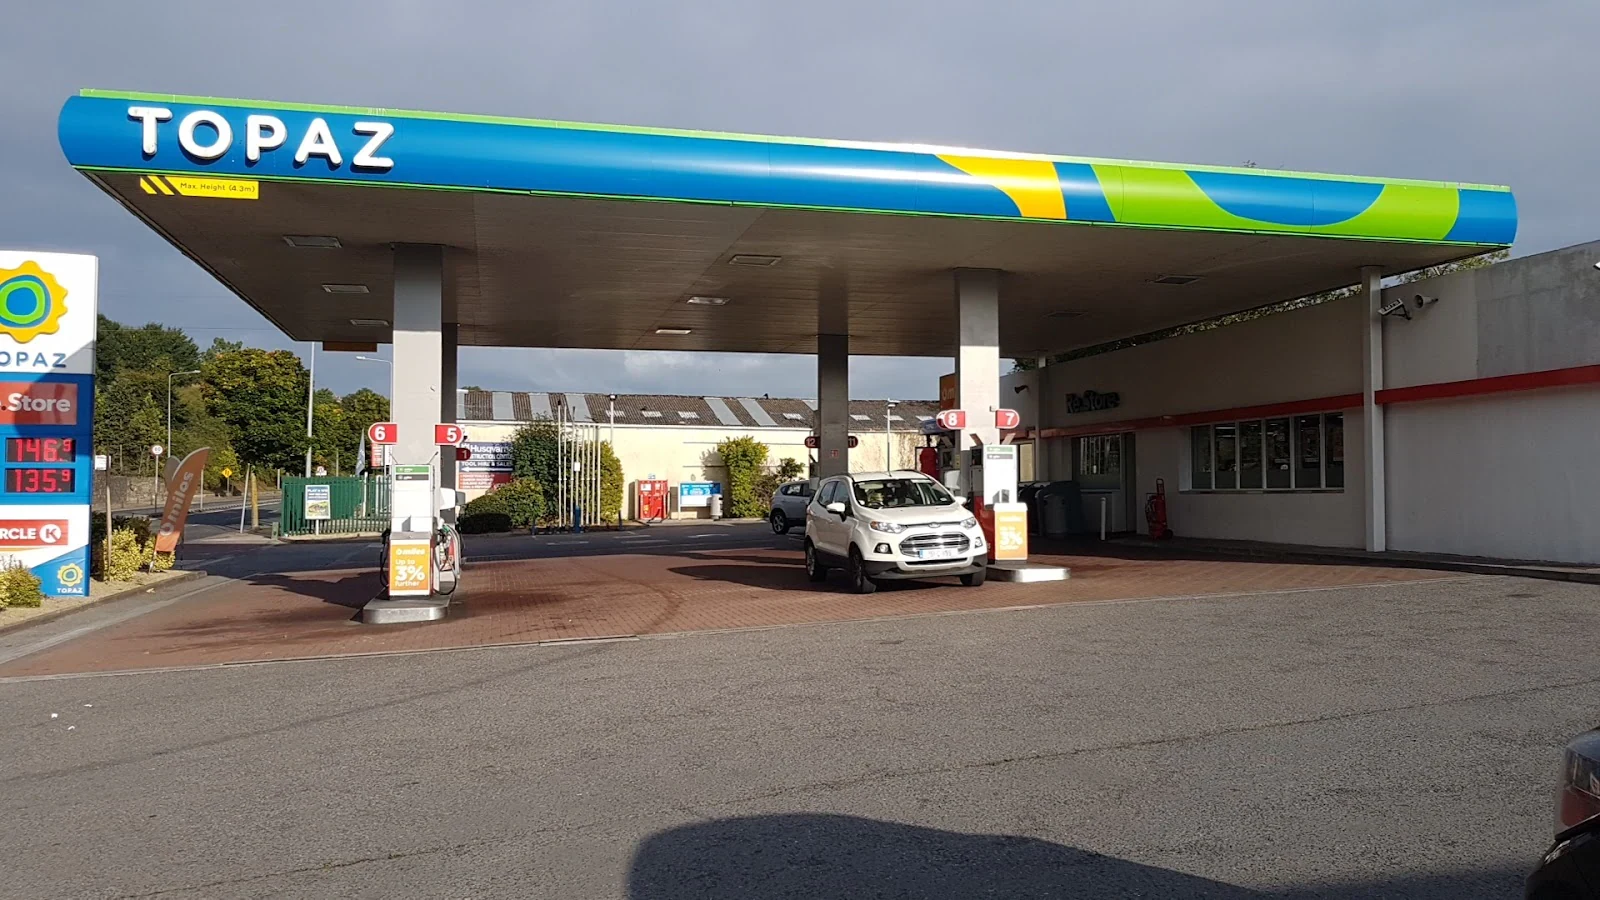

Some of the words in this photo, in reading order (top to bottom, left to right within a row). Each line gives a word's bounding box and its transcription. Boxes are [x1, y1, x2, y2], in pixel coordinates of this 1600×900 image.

[127, 106, 395, 168] TOPAZ
[200, 183, 227, 193] Height
[229, 184, 256, 193] (4.3m)
[0, 392, 71, 412] .Store
[948, 413, 958, 426] 8
[1005, 413, 1015, 426] 7
[375, 427, 386, 441] 6
[446, 427, 458, 442] 5
[806, 438, 816, 447] 12
[848, 438, 856, 446] 11
[15, 438, 73, 462] 146.9
[462, 450, 467, 459] 1
[14, 469, 71, 492] 135.9
[395, 565, 426, 581] 3%
[395, 580, 420, 588] further
